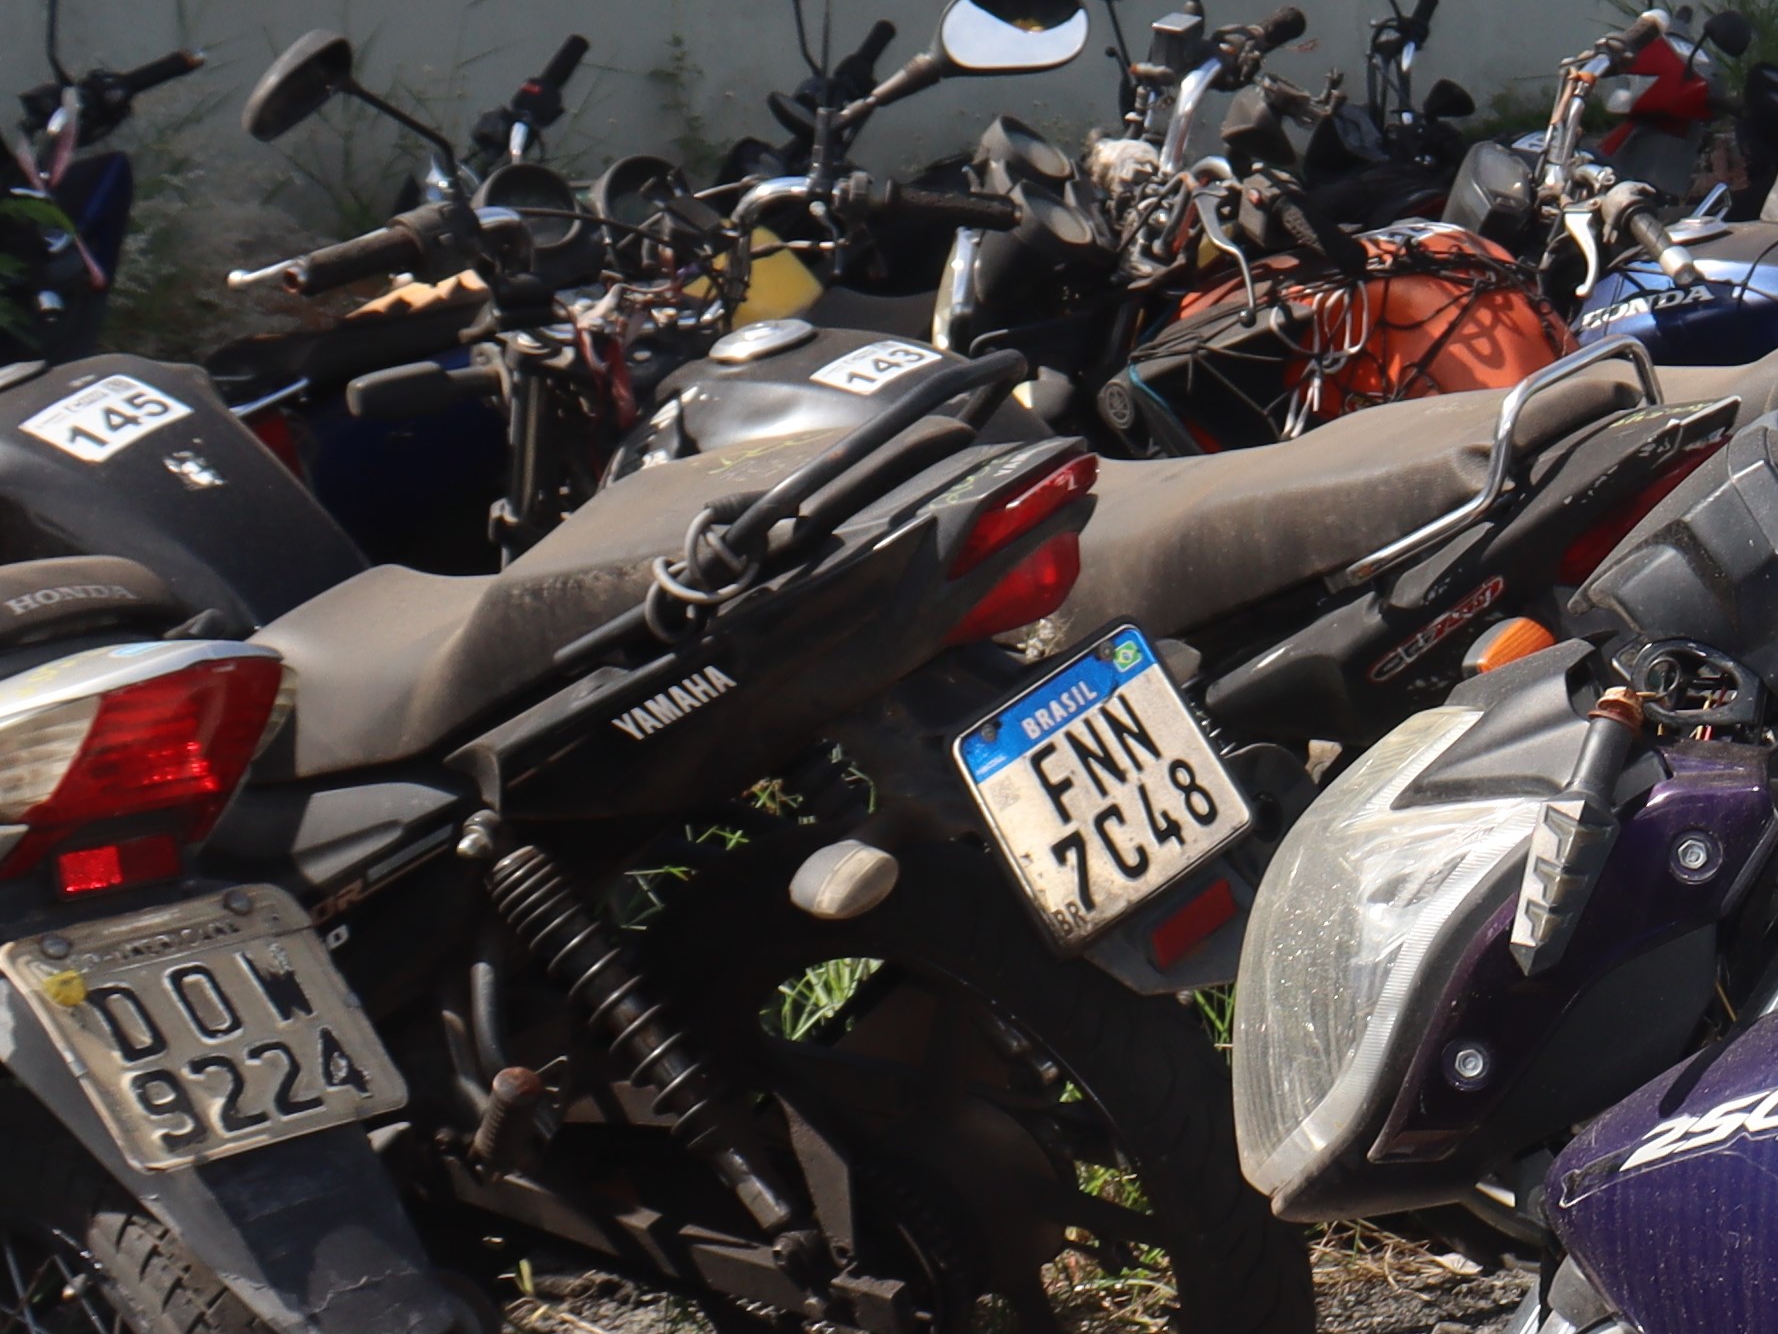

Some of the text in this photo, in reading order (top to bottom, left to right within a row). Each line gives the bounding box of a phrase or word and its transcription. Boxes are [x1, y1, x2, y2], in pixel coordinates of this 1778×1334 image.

[846, 347, 924, 384] 143
[69, 392, 170, 448] 145
[4, 583, 139, 617] HONDA
[611, 665, 738, 741] YAMAHA
[1021, 680, 1098, 741] BRASIL
[1029, 692, 1162, 827] FNN
[1051, 759, 1218, 912] 7C48
[131, 1025, 374, 1154] 9224
